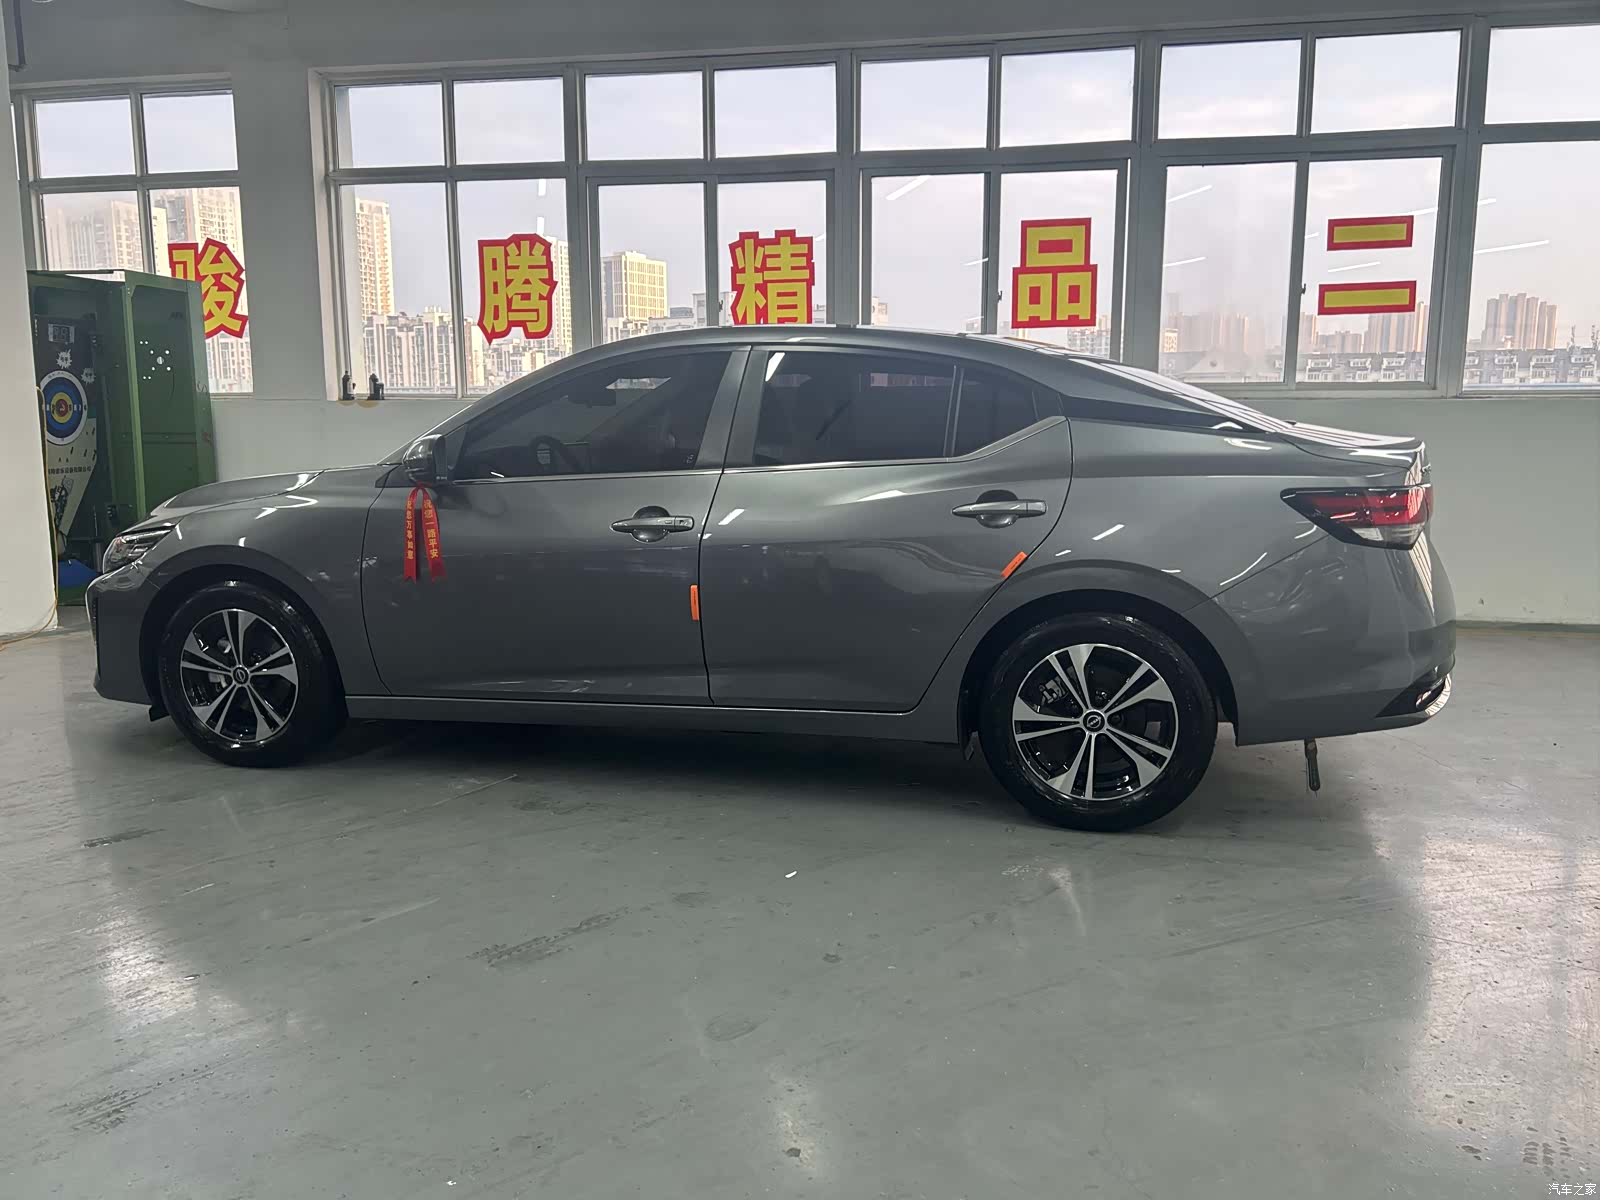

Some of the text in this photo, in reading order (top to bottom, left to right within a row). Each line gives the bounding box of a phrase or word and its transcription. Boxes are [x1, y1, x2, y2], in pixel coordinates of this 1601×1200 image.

[170, 219, 1413, 337] 骏 腾 精 品 二
